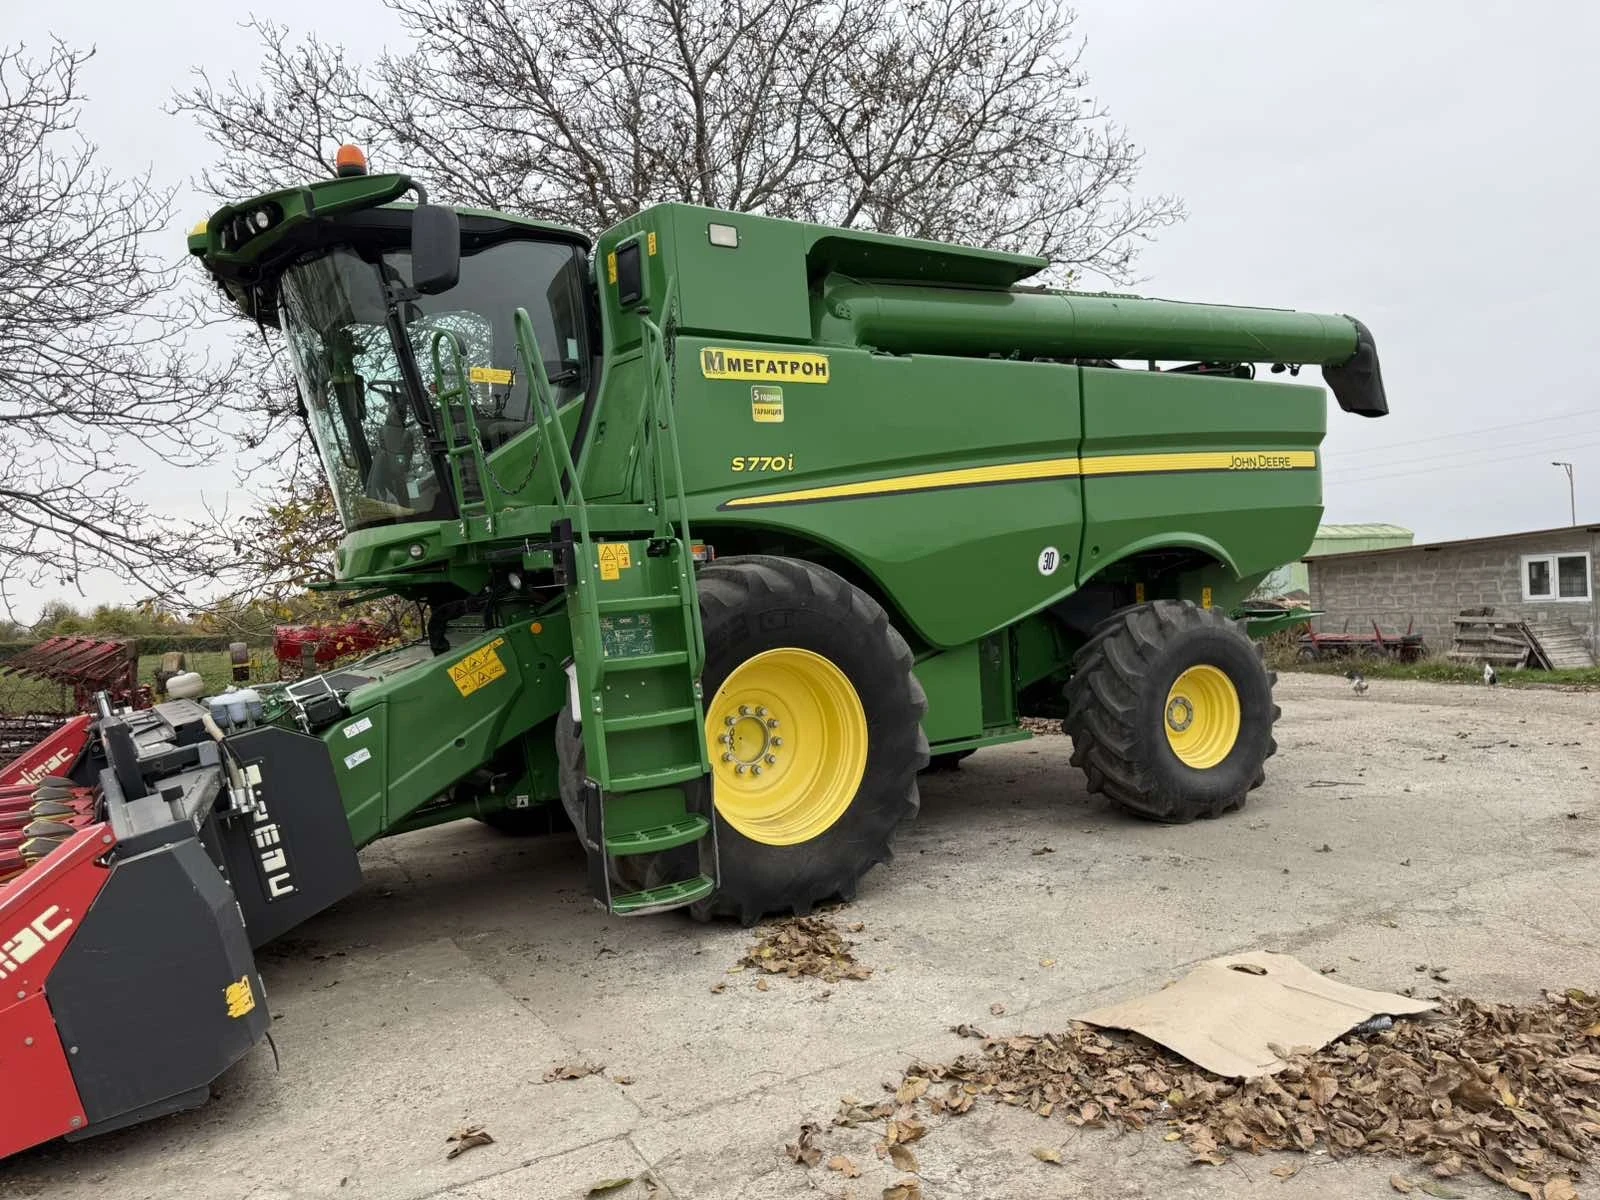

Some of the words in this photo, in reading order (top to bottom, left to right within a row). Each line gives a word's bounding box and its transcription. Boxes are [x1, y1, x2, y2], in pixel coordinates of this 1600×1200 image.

[727, 358, 827, 376] МЕГАТРОН
[753, 390, 760, 401] 5
[731, 453, 794, 471] S770i
[1230, 455, 1257, 468] JOHN
[1258, 454, 1291, 467] DEERE
[1042, 551, 1055, 571] 30
